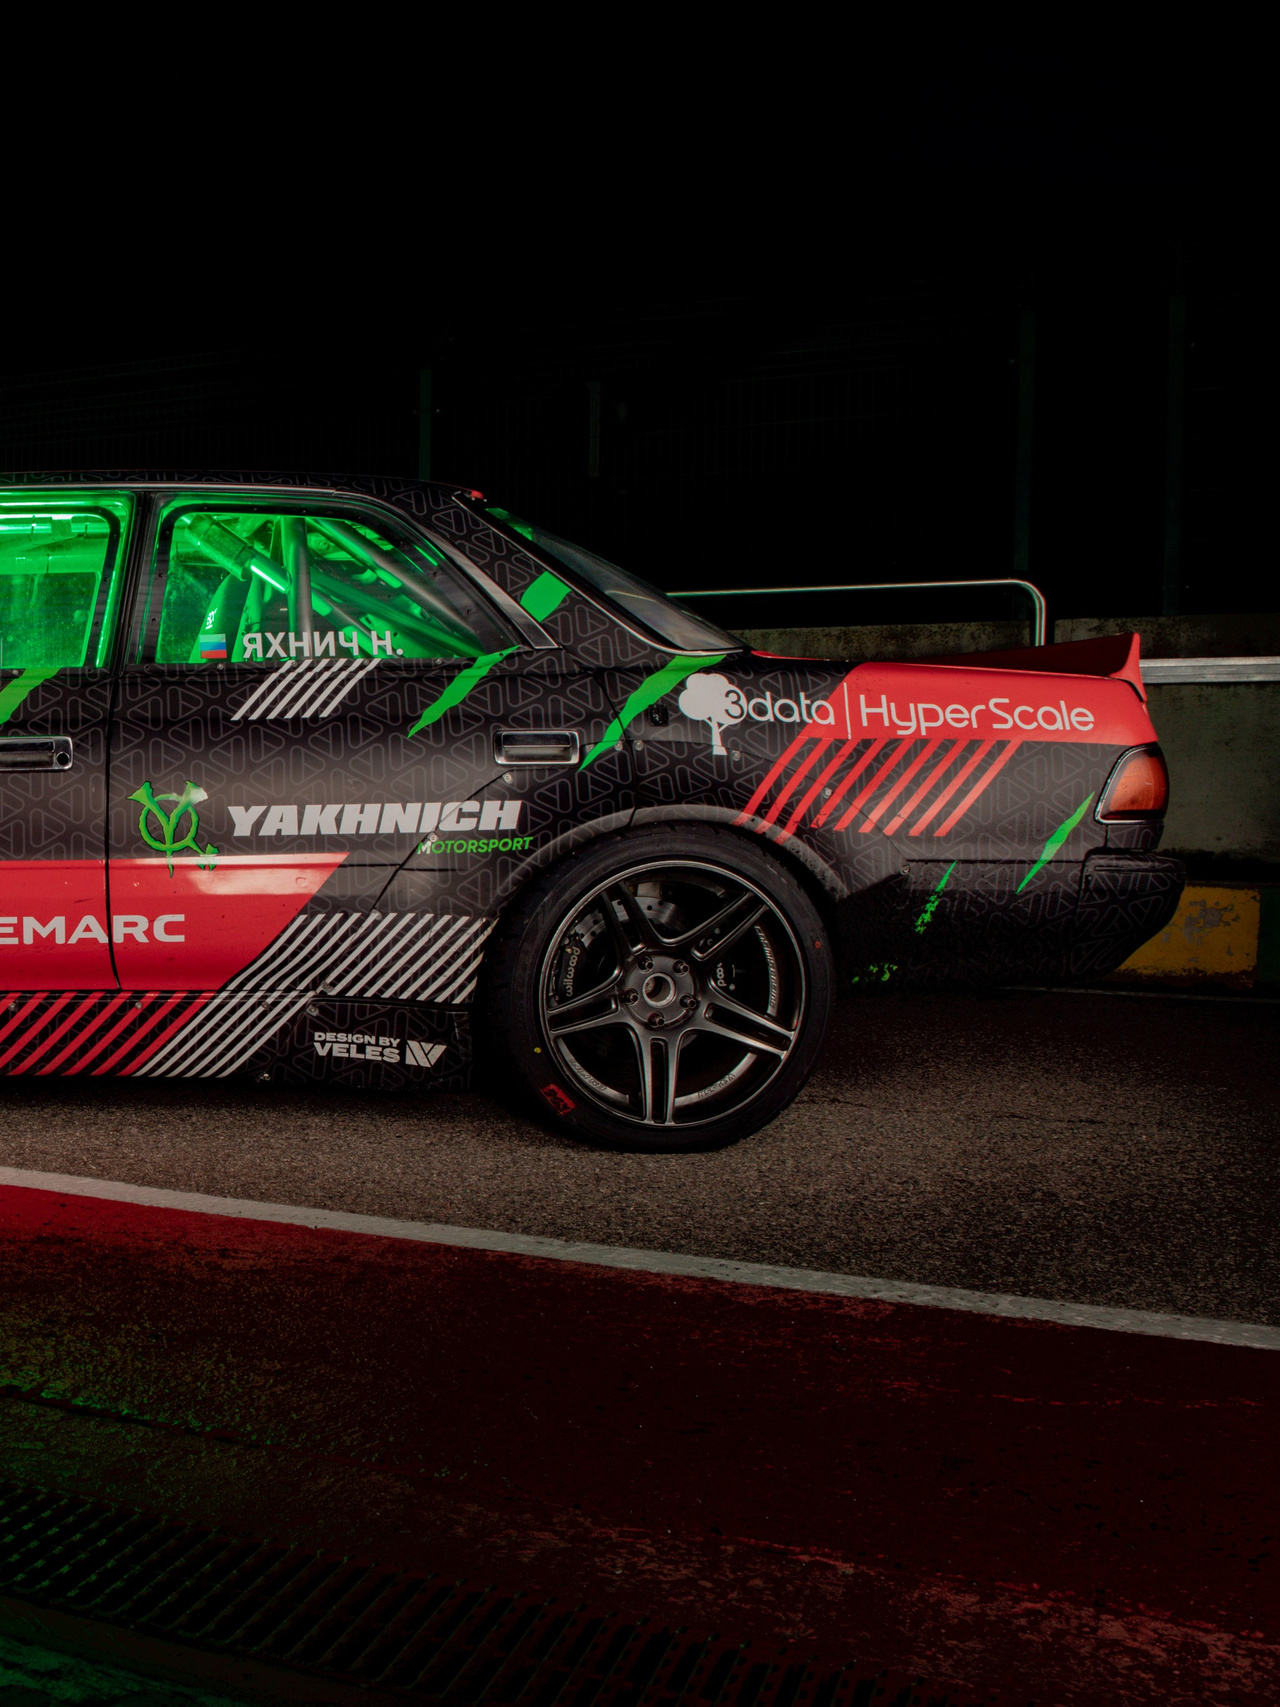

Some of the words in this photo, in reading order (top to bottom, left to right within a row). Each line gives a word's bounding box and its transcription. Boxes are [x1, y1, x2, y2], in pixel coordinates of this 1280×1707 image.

[242, 631, 360, 658] ЯХНИЧ
[371, 631, 404, 657] Н.
[724, 691, 835, 726] 3data
[859, 694, 1095, 736] HyperScale
[227, 800, 522, 836] YAKHNICH
[416, 836, 534, 855] MOTORSPORT
[563, 945, 581, 997] wilwood
[313, 1042, 401, 1064] VELES
[314, 1031, 376, 1045] DESIGN
[378, 1036, 401, 1048] BY
